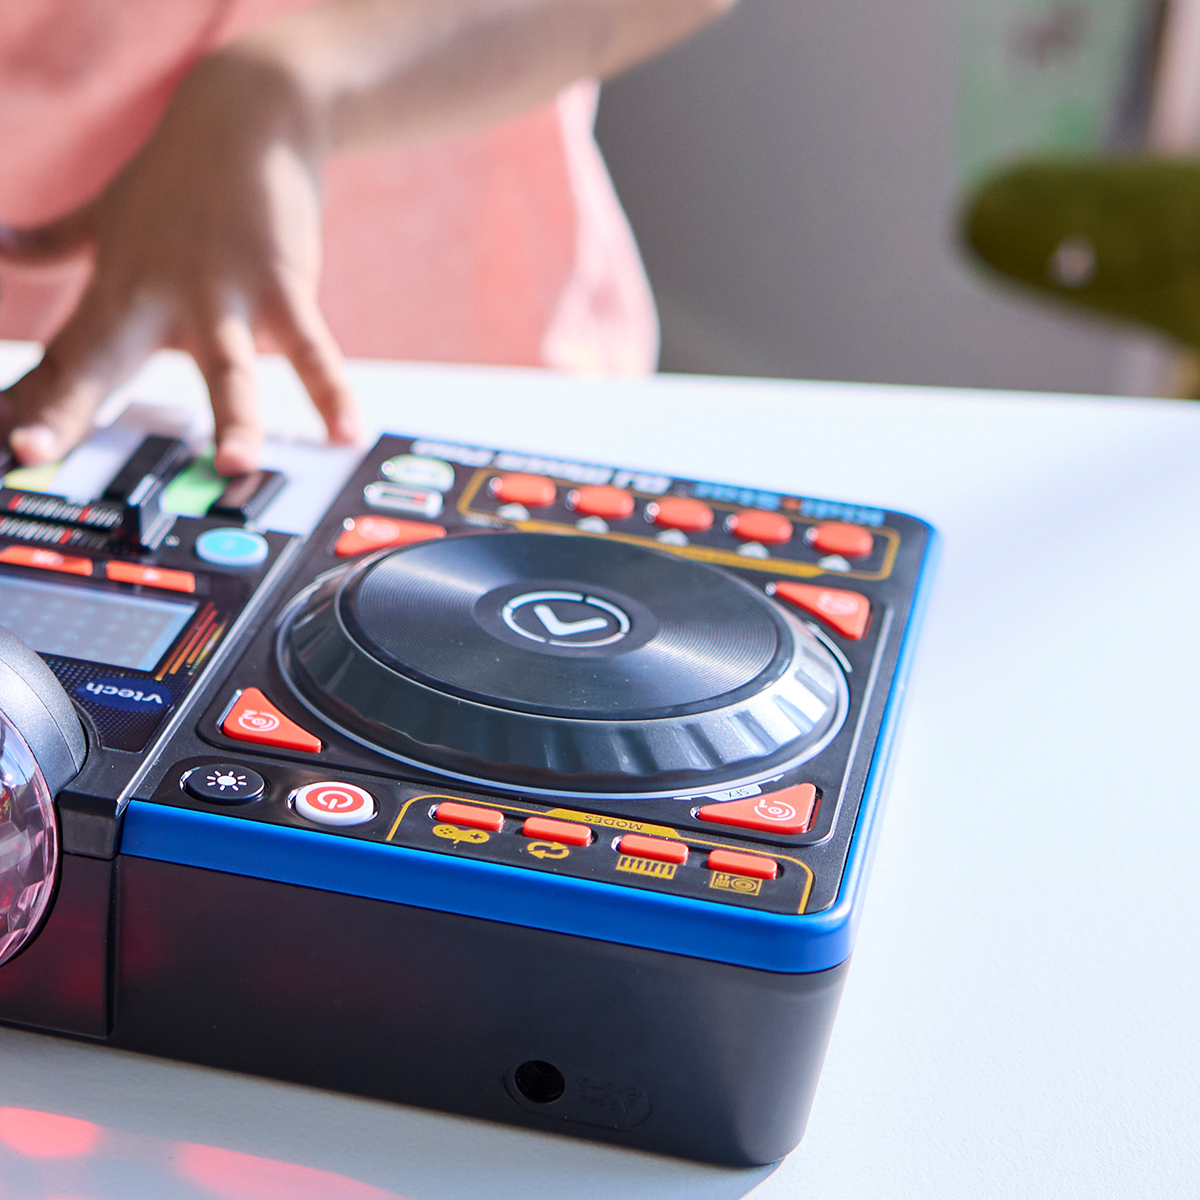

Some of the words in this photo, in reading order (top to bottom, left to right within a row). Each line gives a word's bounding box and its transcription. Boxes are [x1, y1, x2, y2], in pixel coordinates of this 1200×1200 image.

[241, 708, 258, 720] 2
[724, 788, 750, 799] SFX
[758, 799, 768, 808] 1
[584, 814, 643, 831] MODES
